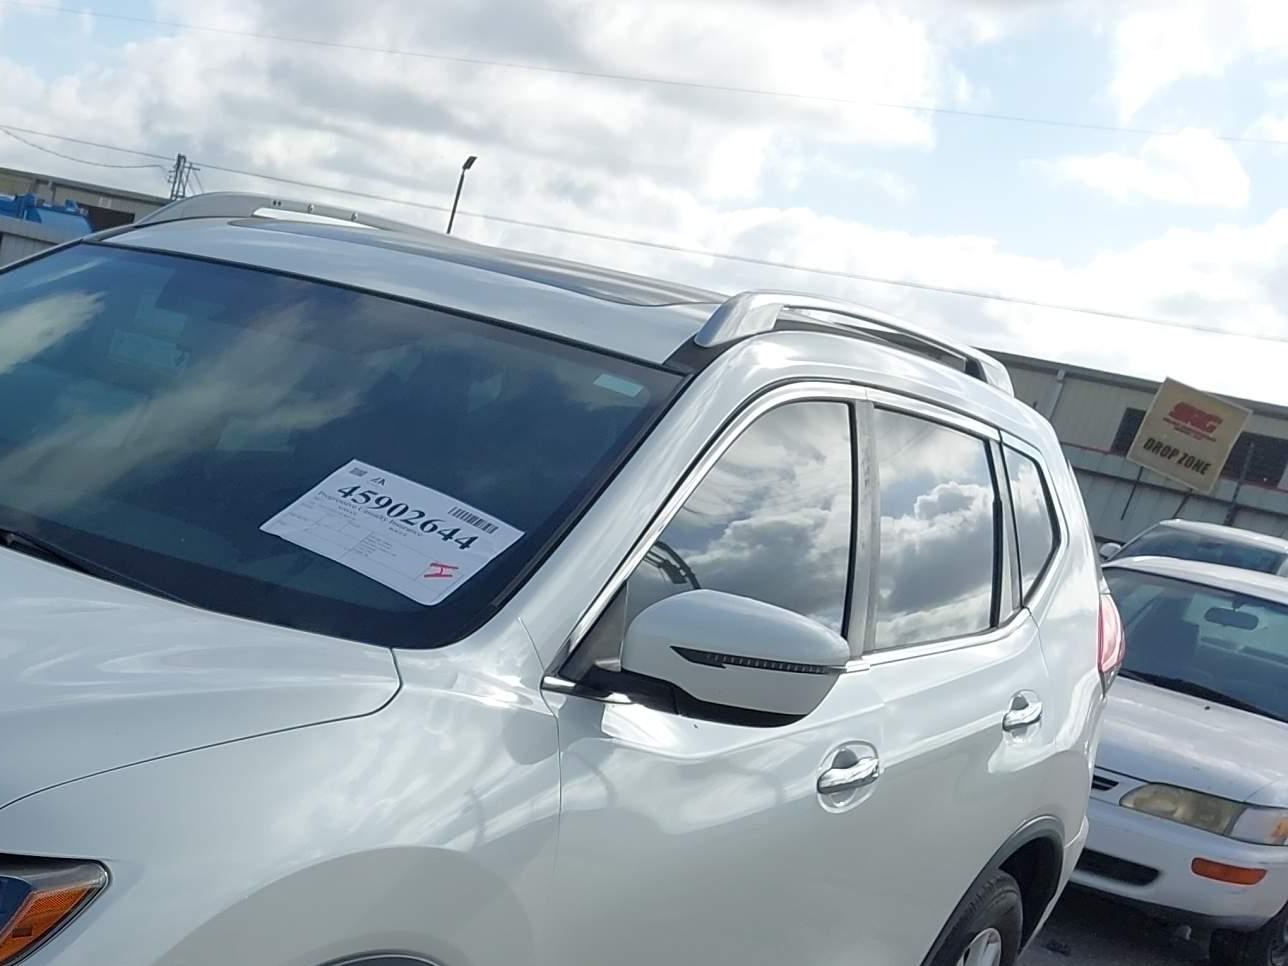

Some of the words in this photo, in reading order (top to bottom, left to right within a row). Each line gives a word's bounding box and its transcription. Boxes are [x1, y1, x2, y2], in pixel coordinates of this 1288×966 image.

[1143, 437, 1179, 460] DROP
[1177, 452, 1211, 475] ZONE
[336, 485, 479, 550] 45902644
